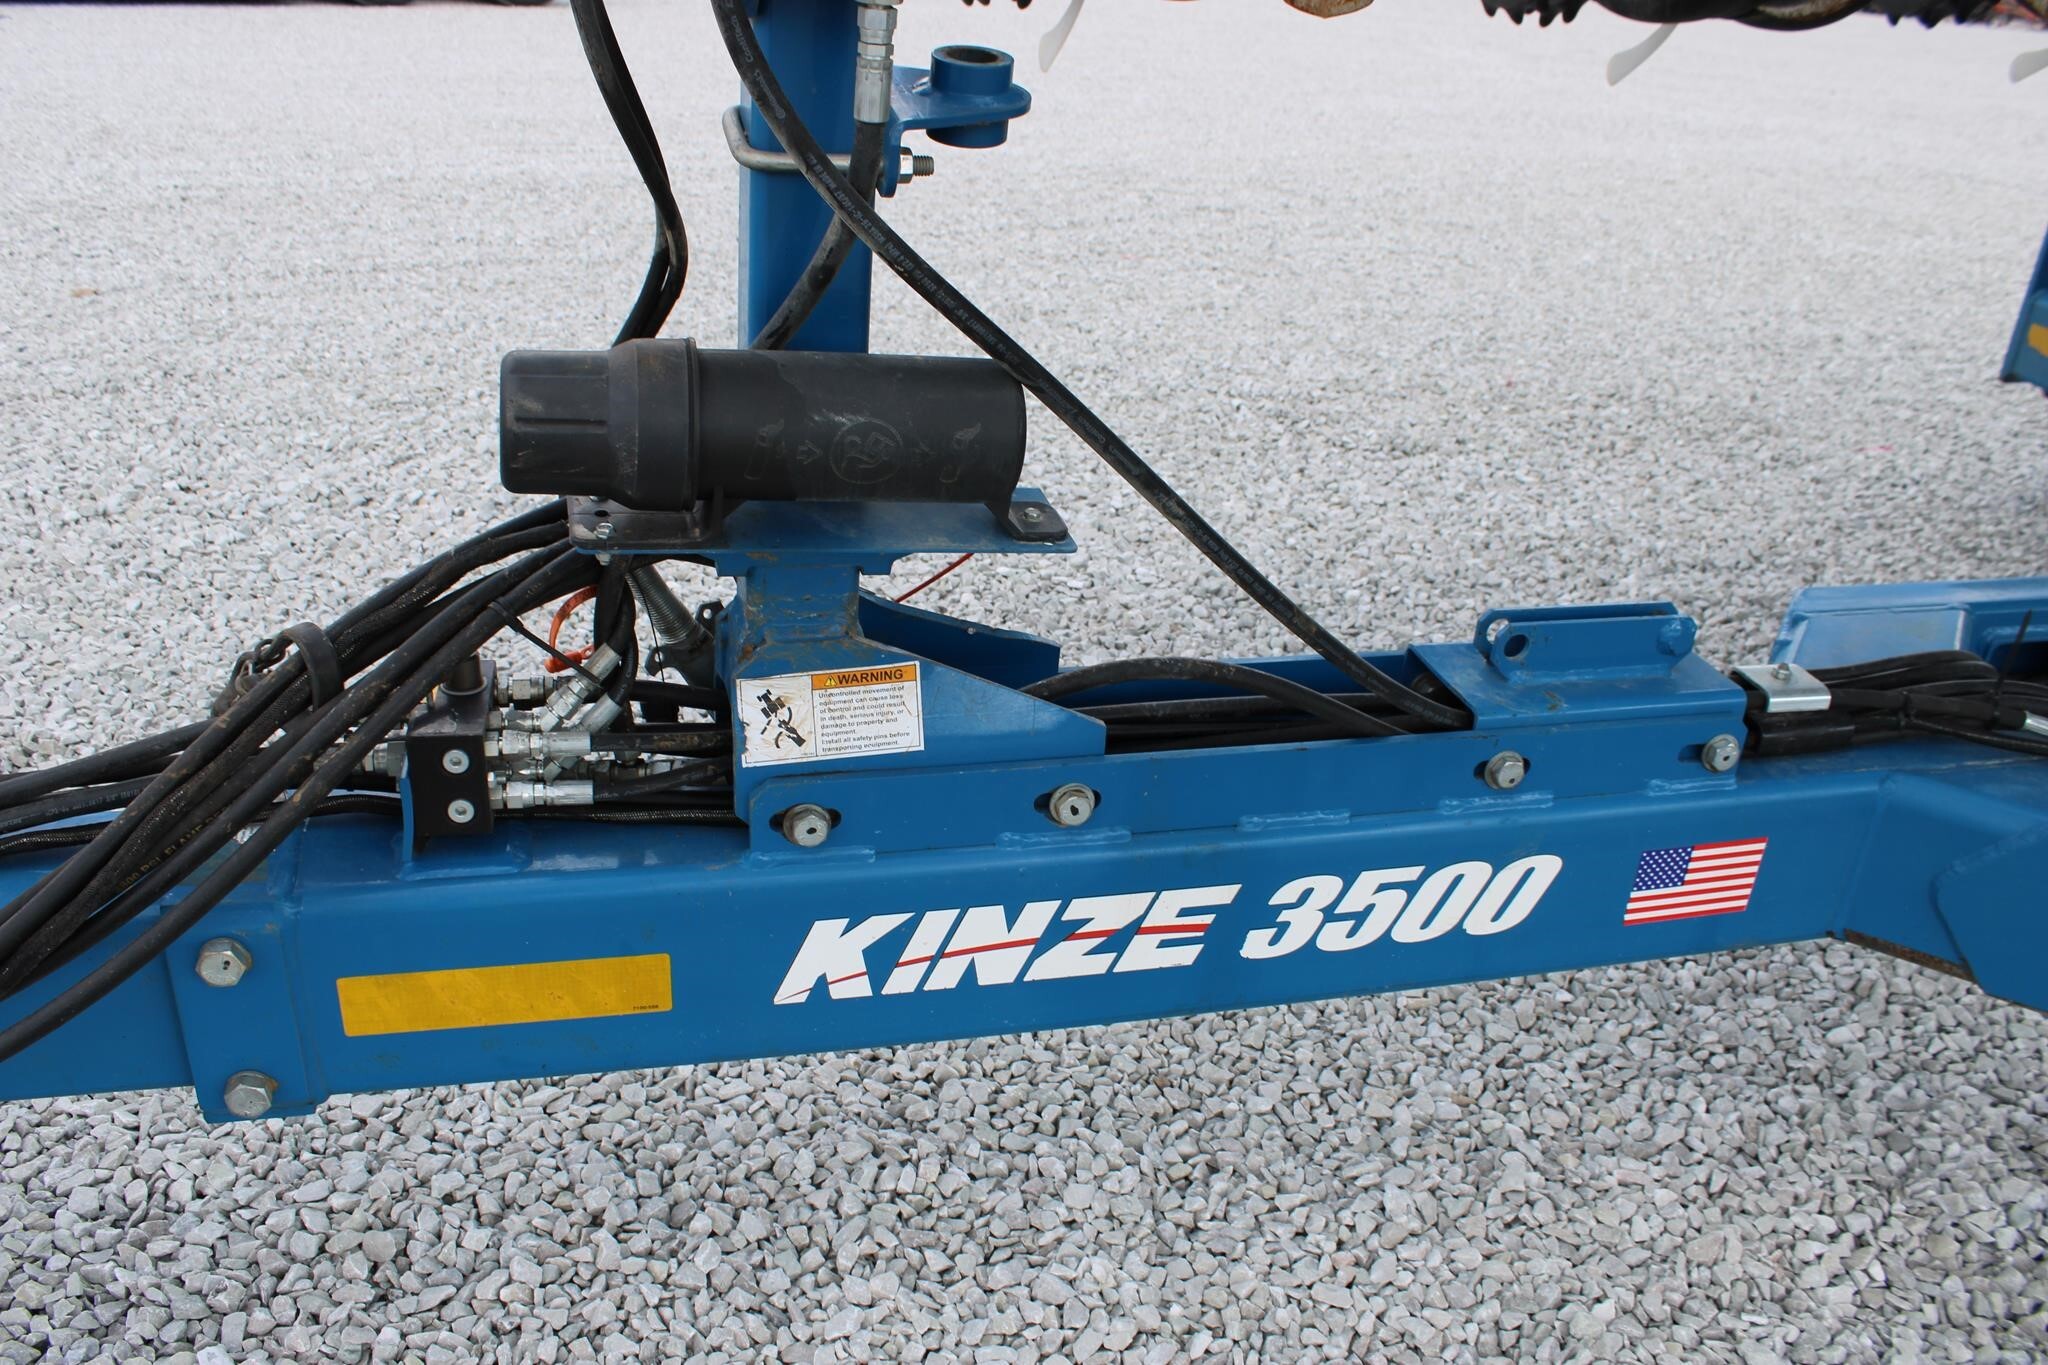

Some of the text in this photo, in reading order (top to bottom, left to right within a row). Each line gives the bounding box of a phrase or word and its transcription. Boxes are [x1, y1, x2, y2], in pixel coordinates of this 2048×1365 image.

[837, 669, 903, 685] WARNING
[819, 689, 860, 698] Uncontrolled
[862, 686, 896, 695] movement
[819, 698, 854, 707] equipment
[855, 695, 867, 703] can
[869, 694, 888, 702] cause
[828, 705, 851, 713] control
[853, 703, 865, 711] and
[867, 702, 885, 710] could
[850, 711, 875, 719] serious
[821, 722, 847, 730] damage
[856, 719, 883, 728] property
[853, 735, 873, 743] safety
[874, 733, 888, 742] pins
[888, 731, 910, 739] before
[822, 743, 863, 753] transporting
[774, 854, 1563, 1006] KINZE 3500
